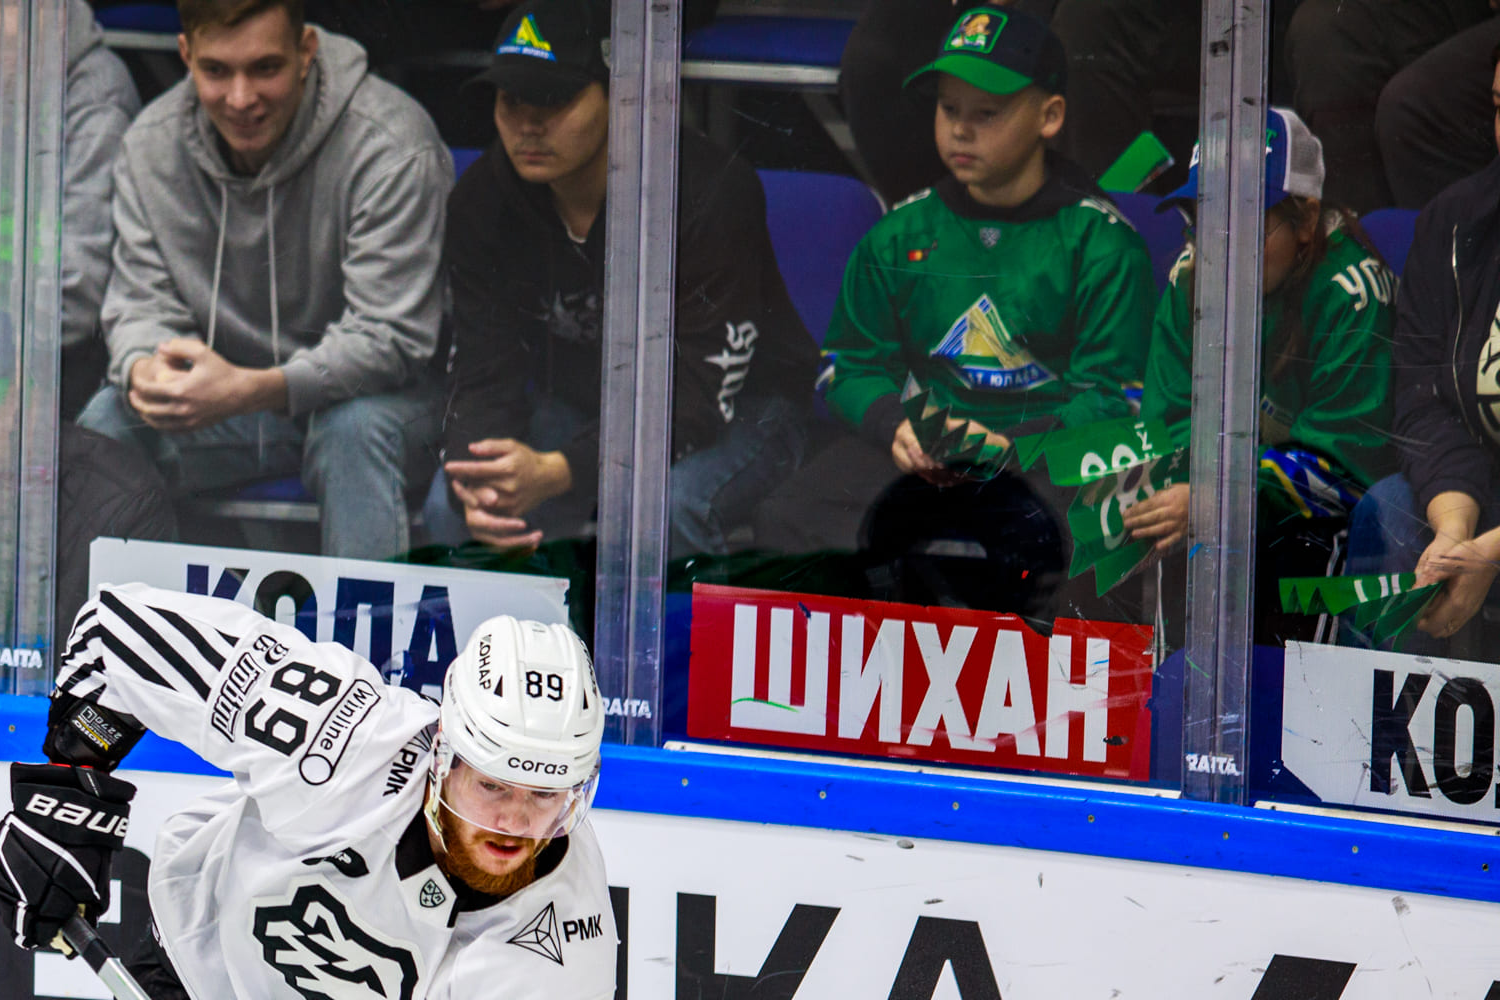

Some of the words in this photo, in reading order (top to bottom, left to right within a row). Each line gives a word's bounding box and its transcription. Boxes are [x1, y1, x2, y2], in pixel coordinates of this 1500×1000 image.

[244, 660, 342, 757] 89
[526, 670, 564, 702] 89
[730, 603, 1110, 762] ШИХАН
[320, 687, 374, 751] Winline
[1369, 668, 1500, 809] КО
[507, 756, 569, 776] согаз
[1185, 753, 1241, 777] RAITA
